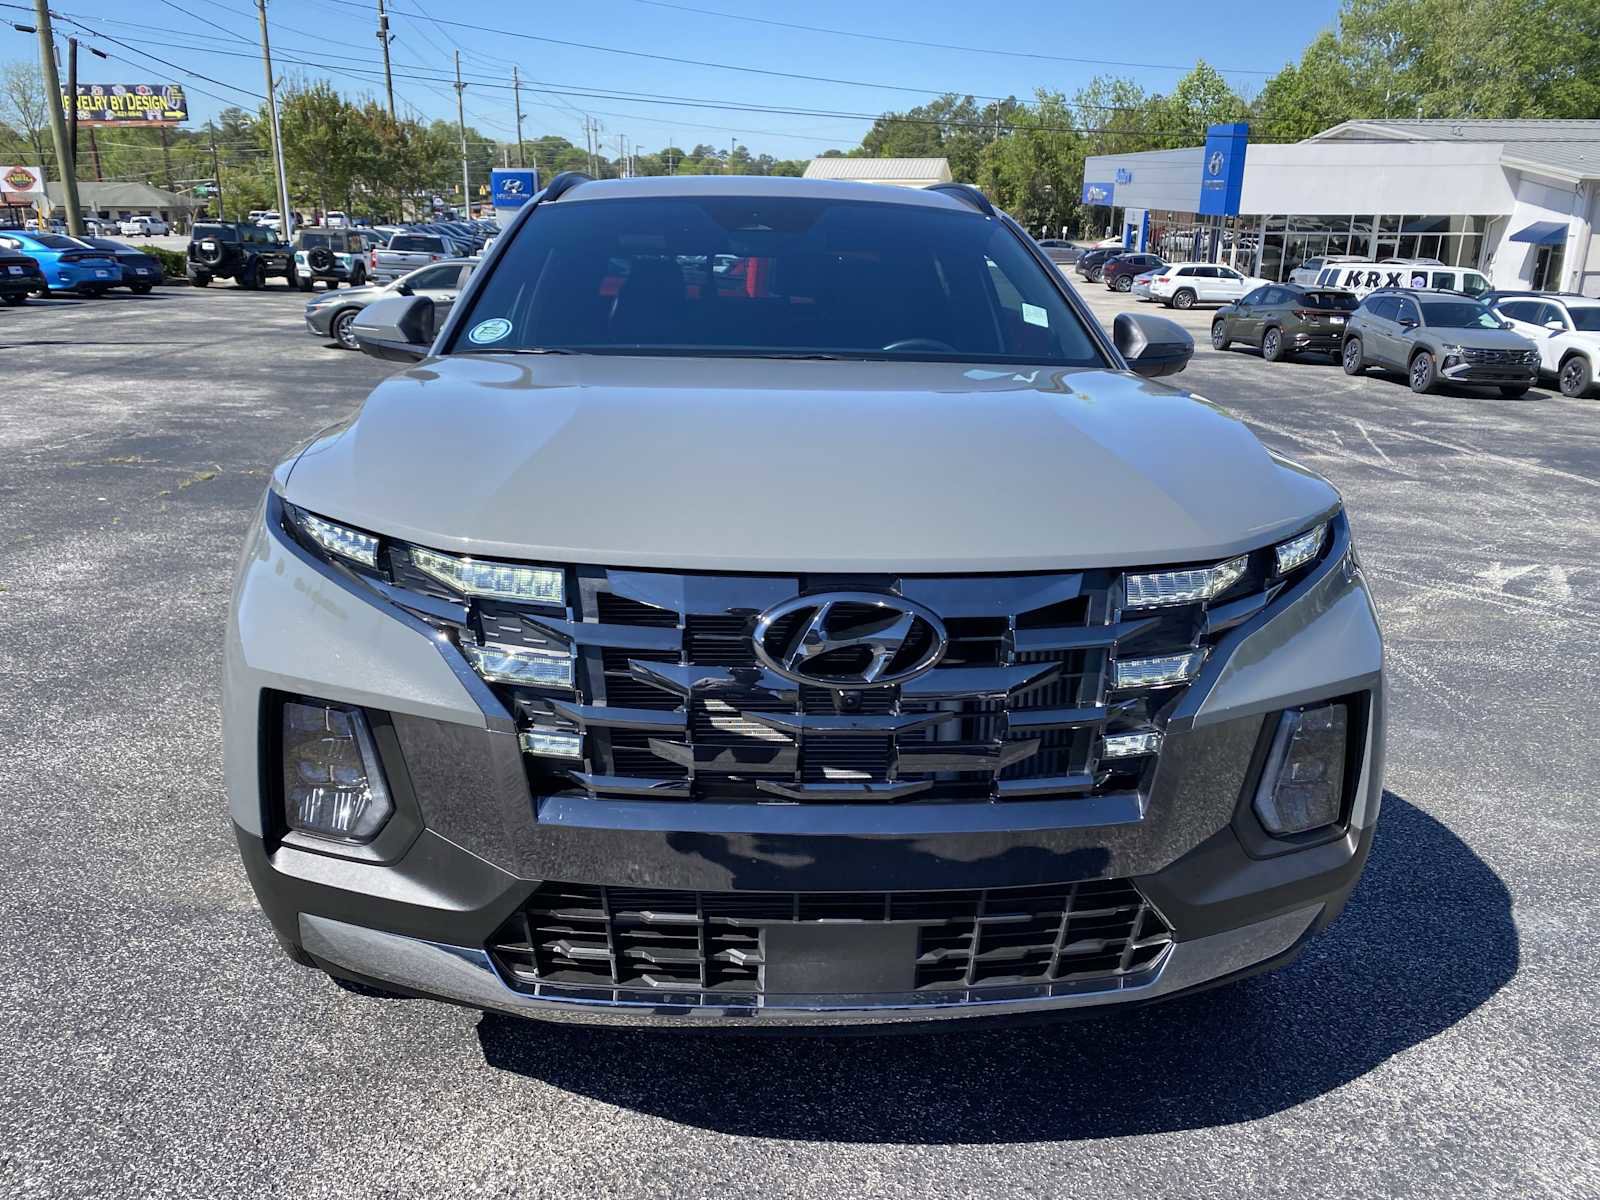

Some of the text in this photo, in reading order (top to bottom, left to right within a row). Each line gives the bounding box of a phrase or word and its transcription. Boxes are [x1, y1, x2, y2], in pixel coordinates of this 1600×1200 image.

[61, 95, 108, 111] EELRY
[109, 95, 124, 110] BY
[126, 93, 168, 111] DESIGN
[1343, 270, 1402, 288] KRX
